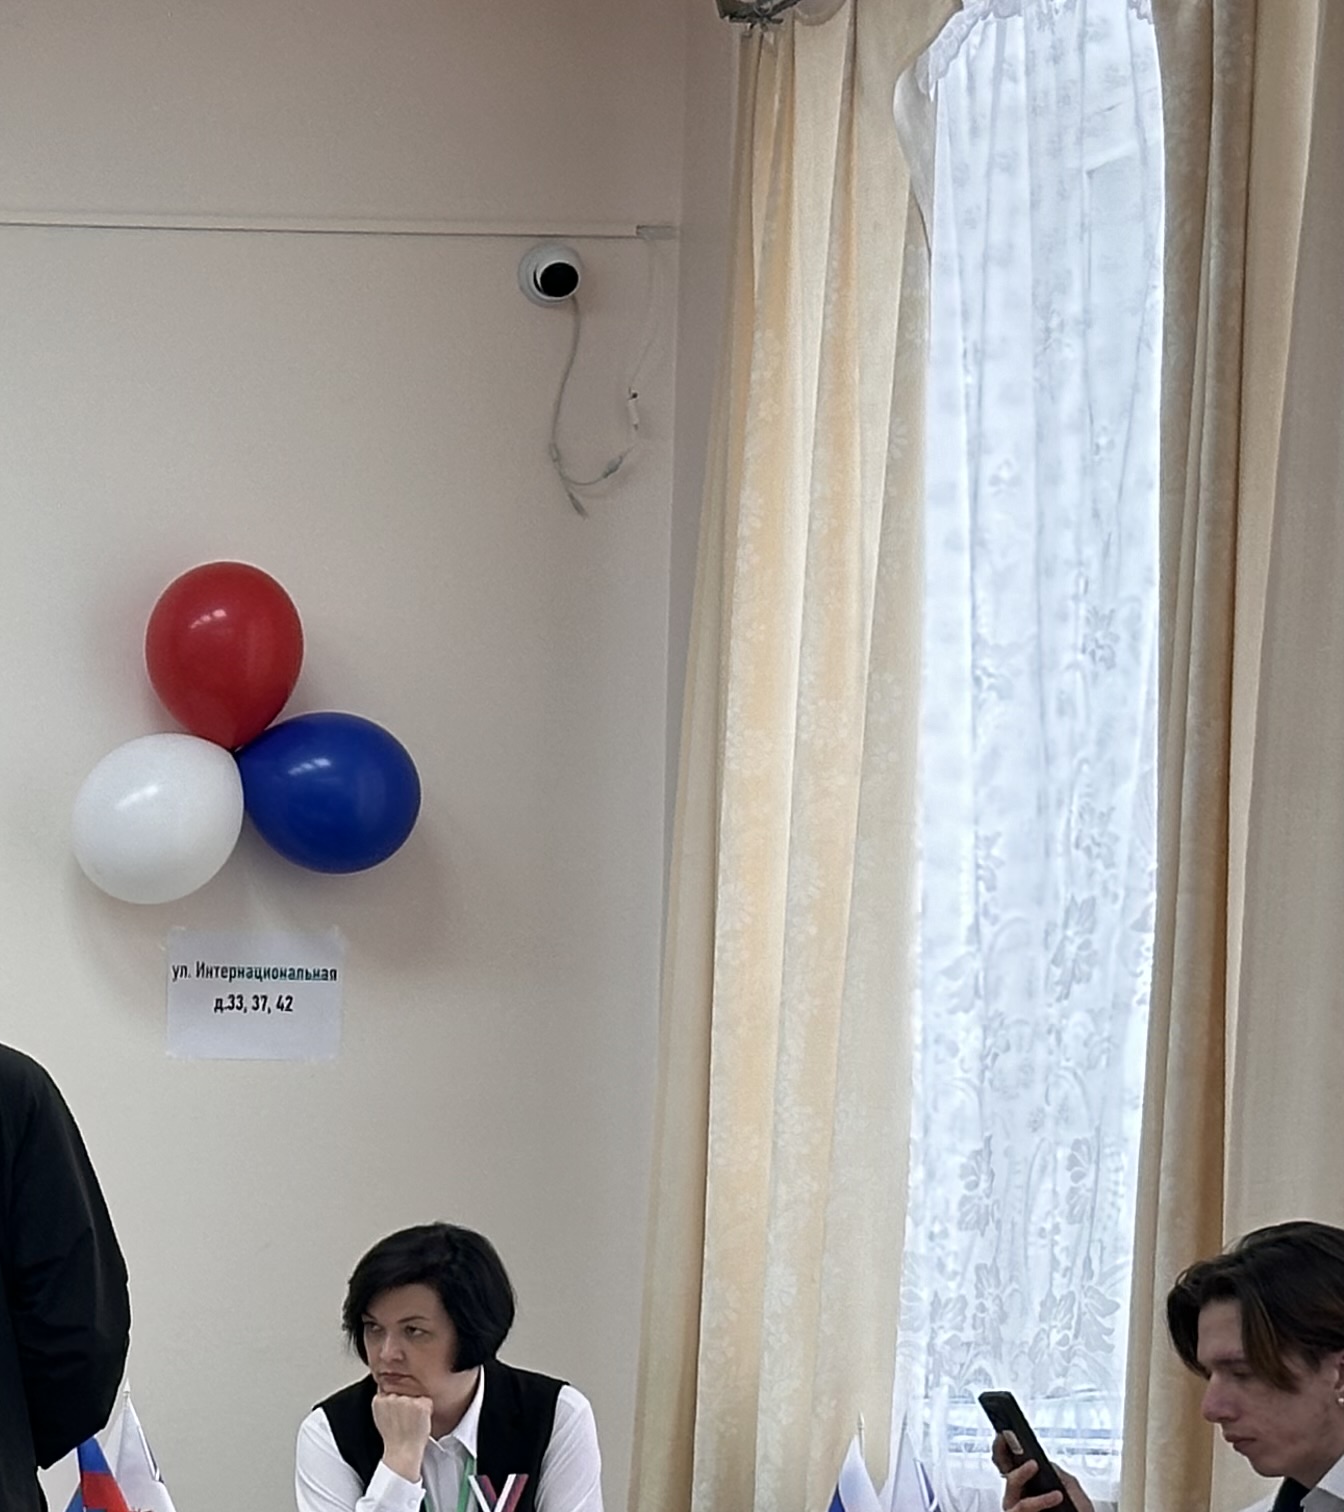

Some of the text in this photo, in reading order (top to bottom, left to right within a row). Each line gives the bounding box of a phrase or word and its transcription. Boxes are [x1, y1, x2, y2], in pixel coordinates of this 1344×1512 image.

[172, 961, 338, 983] ул. Интернациональная
[214, 994, 293, 1014] д.33, 37, 42
